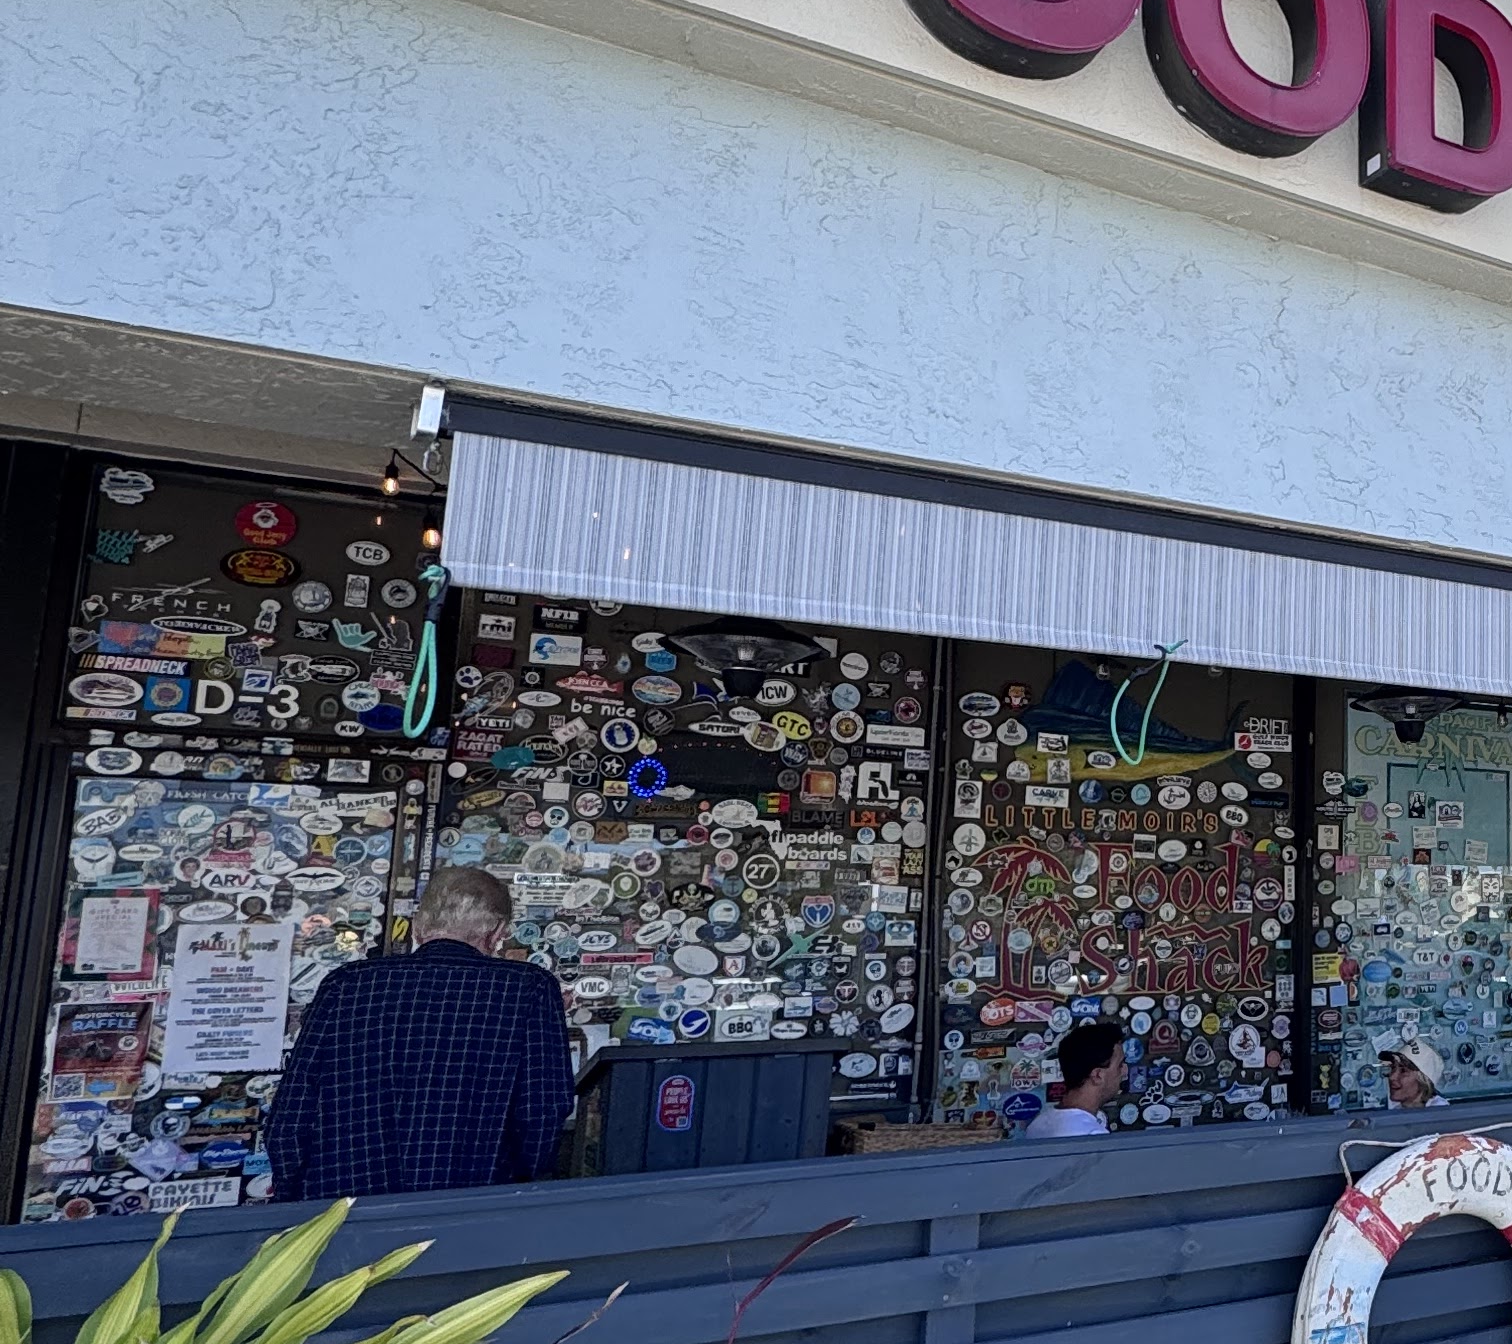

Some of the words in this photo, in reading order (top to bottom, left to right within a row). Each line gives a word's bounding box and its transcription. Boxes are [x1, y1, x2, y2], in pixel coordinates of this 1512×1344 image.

[353, 545, 384, 561] TCB
[111, 592, 231, 613] FRENCH
[95, 654, 188, 676] SPREADNECK
[590, 678, 609, 687] CCA
[195, 679, 300, 719] D-3
[760, 686, 787, 700] ICW
[571, 698, 593, 713] be
[601, 705, 636, 718] nice
[340, 723, 360, 734] KW
[479, 718, 510, 728] YETI
[698, 723, 741, 735] SATORI
[777, 715, 811, 737] GTC
[458, 731, 504, 743] ZAGAT
[456, 741, 503, 753] RATED
[212, 790, 250, 802] CATC
[1032, 787, 1064, 799] CARVE
[792, 810, 845, 826] BLAME
[985, 804, 1096, 829] LITTLE
[1117, 808, 1219, 834] MOIR'S
[786, 829, 845, 846] paddle
[787, 846, 848, 862] boards
[748, 863, 772, 880] 27
[1088, 841, 1240, 915] Food
[208, 873, 251, 888] ARV
[1081, 917, 1275, 995] Shack
[1417, 952, 1435, 962] T&T
[581, 981, 605, 993] VMC
[75, 1010, 137, 1019] MOTORCYCLE
[72, 1019, 137, 1032] RAFFLE
[728, 1021, 753, 1034] BBQ
[1012, 1078, 1038, 1088] IOWA
[151, 1180, 233, 1197] FAYETTE
